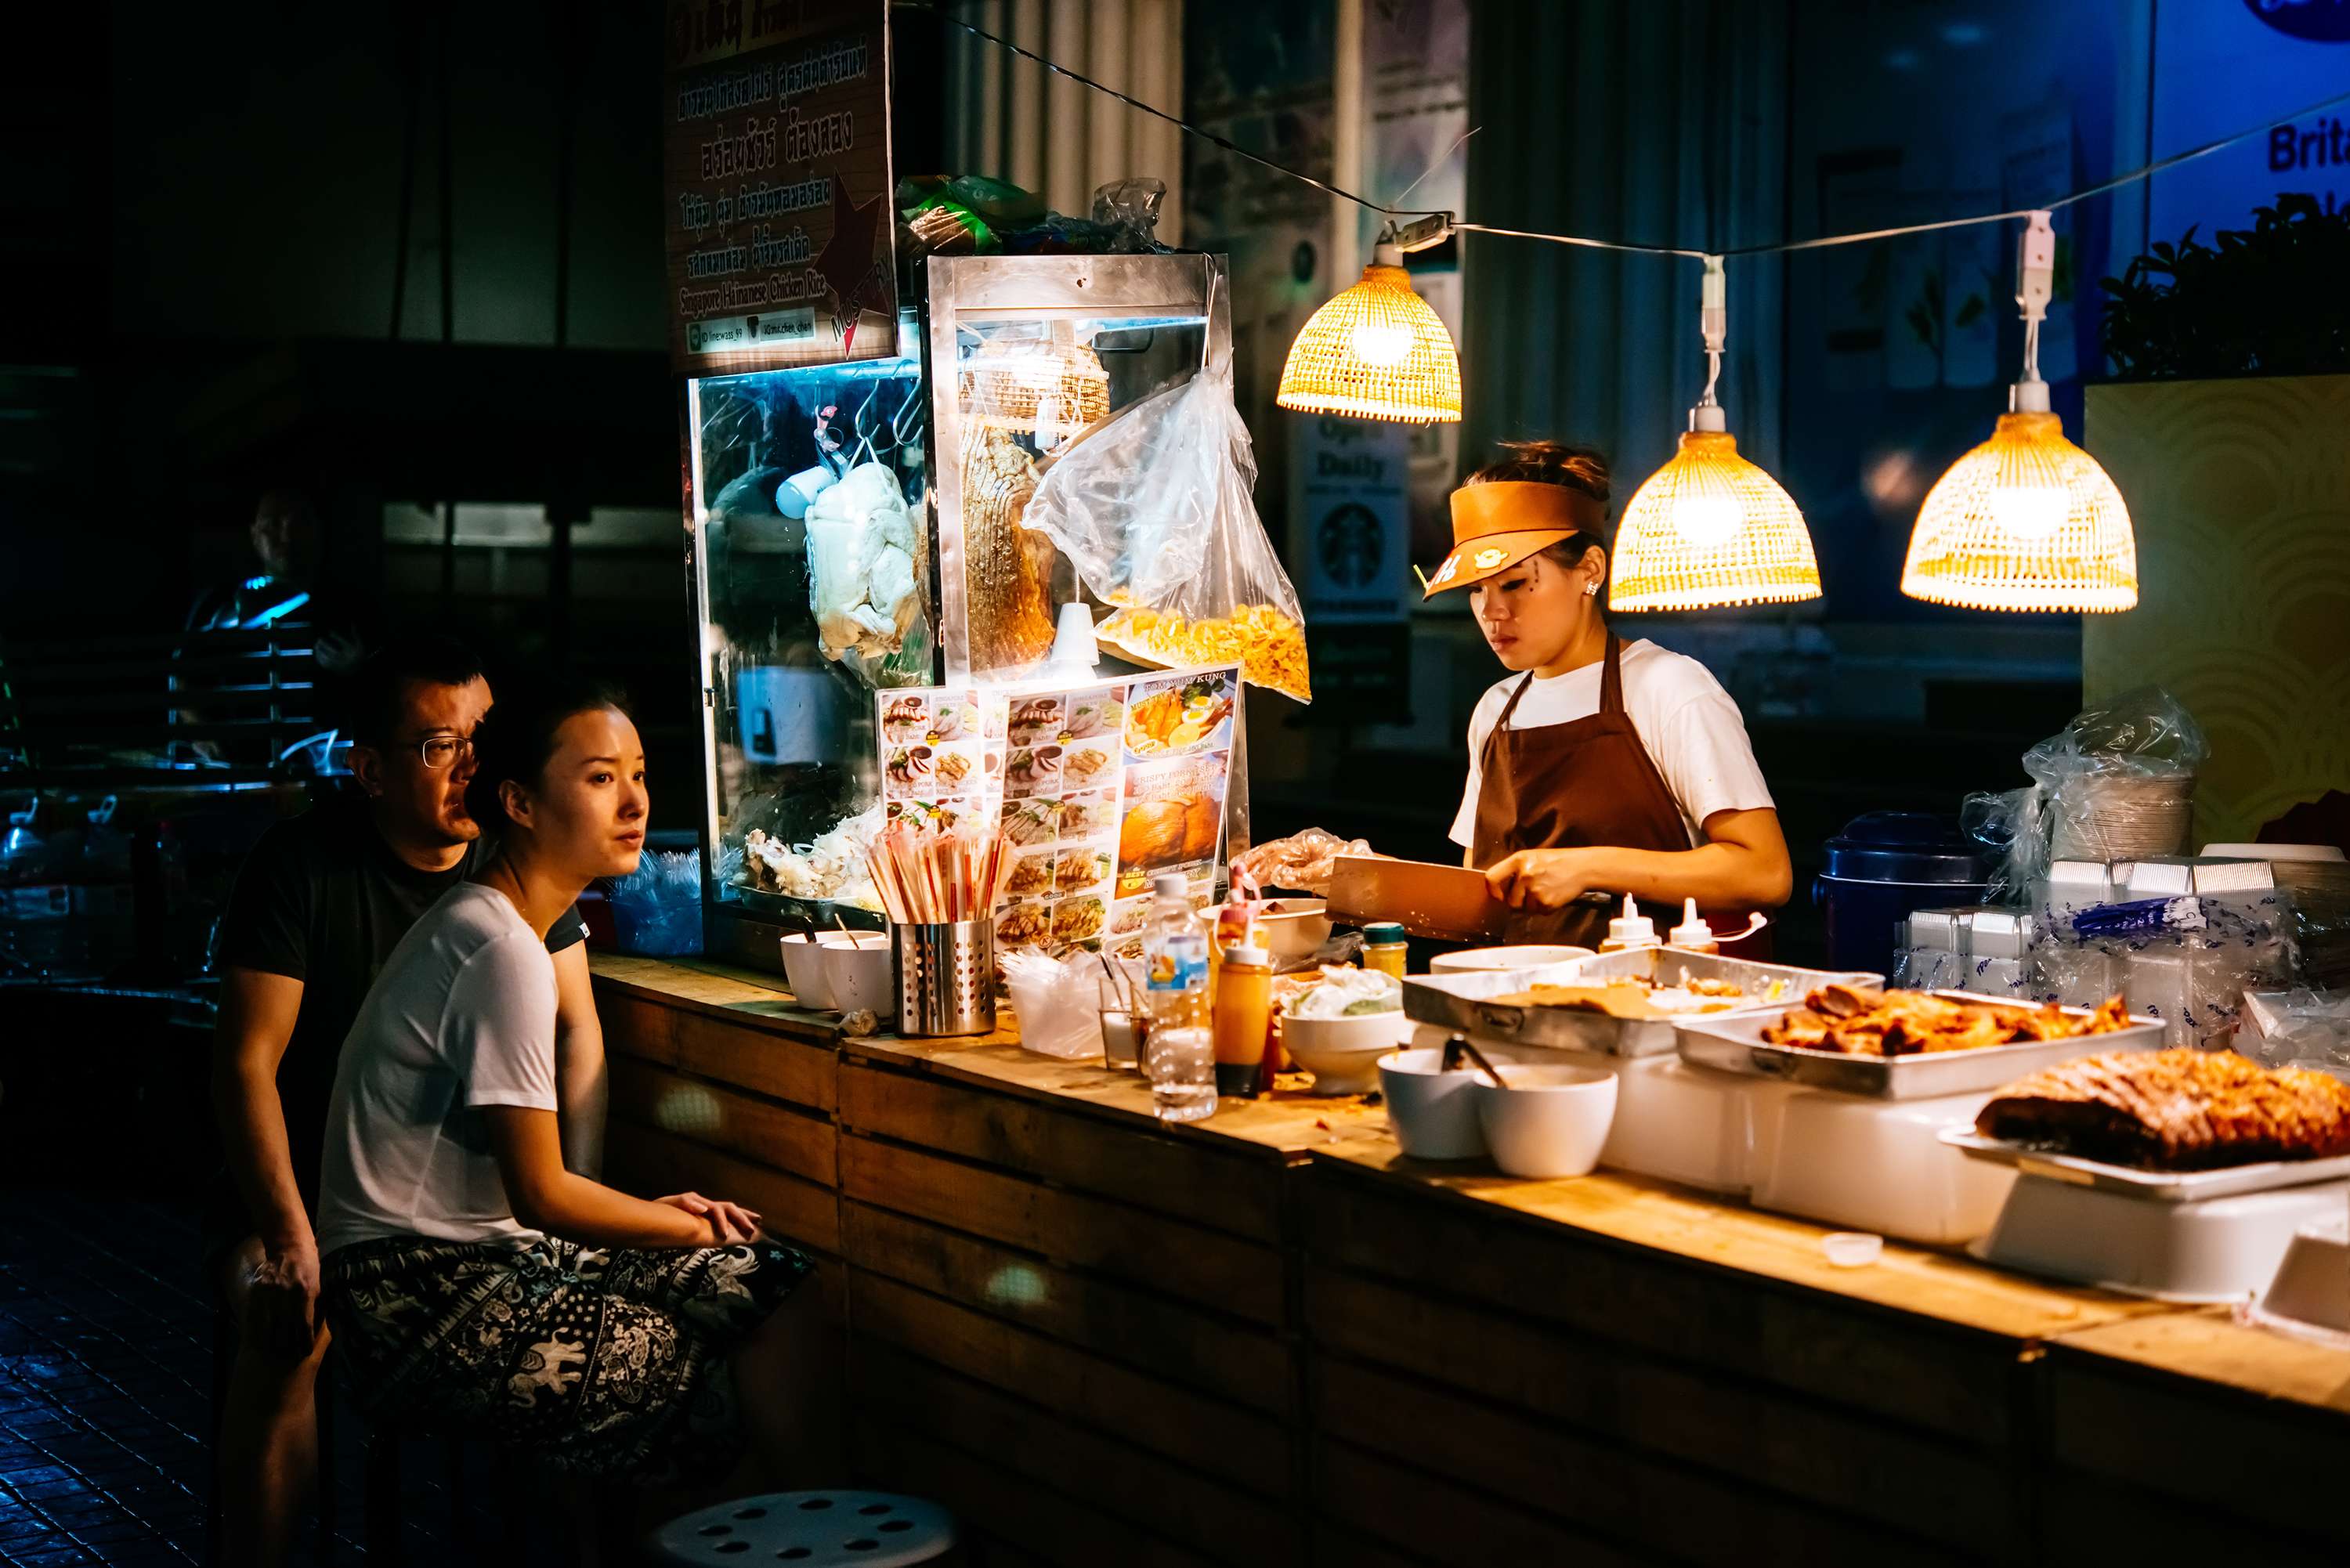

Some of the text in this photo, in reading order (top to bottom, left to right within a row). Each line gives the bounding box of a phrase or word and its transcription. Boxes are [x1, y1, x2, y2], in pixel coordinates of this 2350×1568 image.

[785, 107, 854, 163] ต้องลอง
[2269, 117, 2350, 172] Brit
[680, 286, 721, 319] Singapore
[769, 273, 804, 302] Chicken
[805, 267, 827, 298] Rice
[1144, 681, 1166, 692] TOM
[1196, 671, 1227, 684] KUNG
